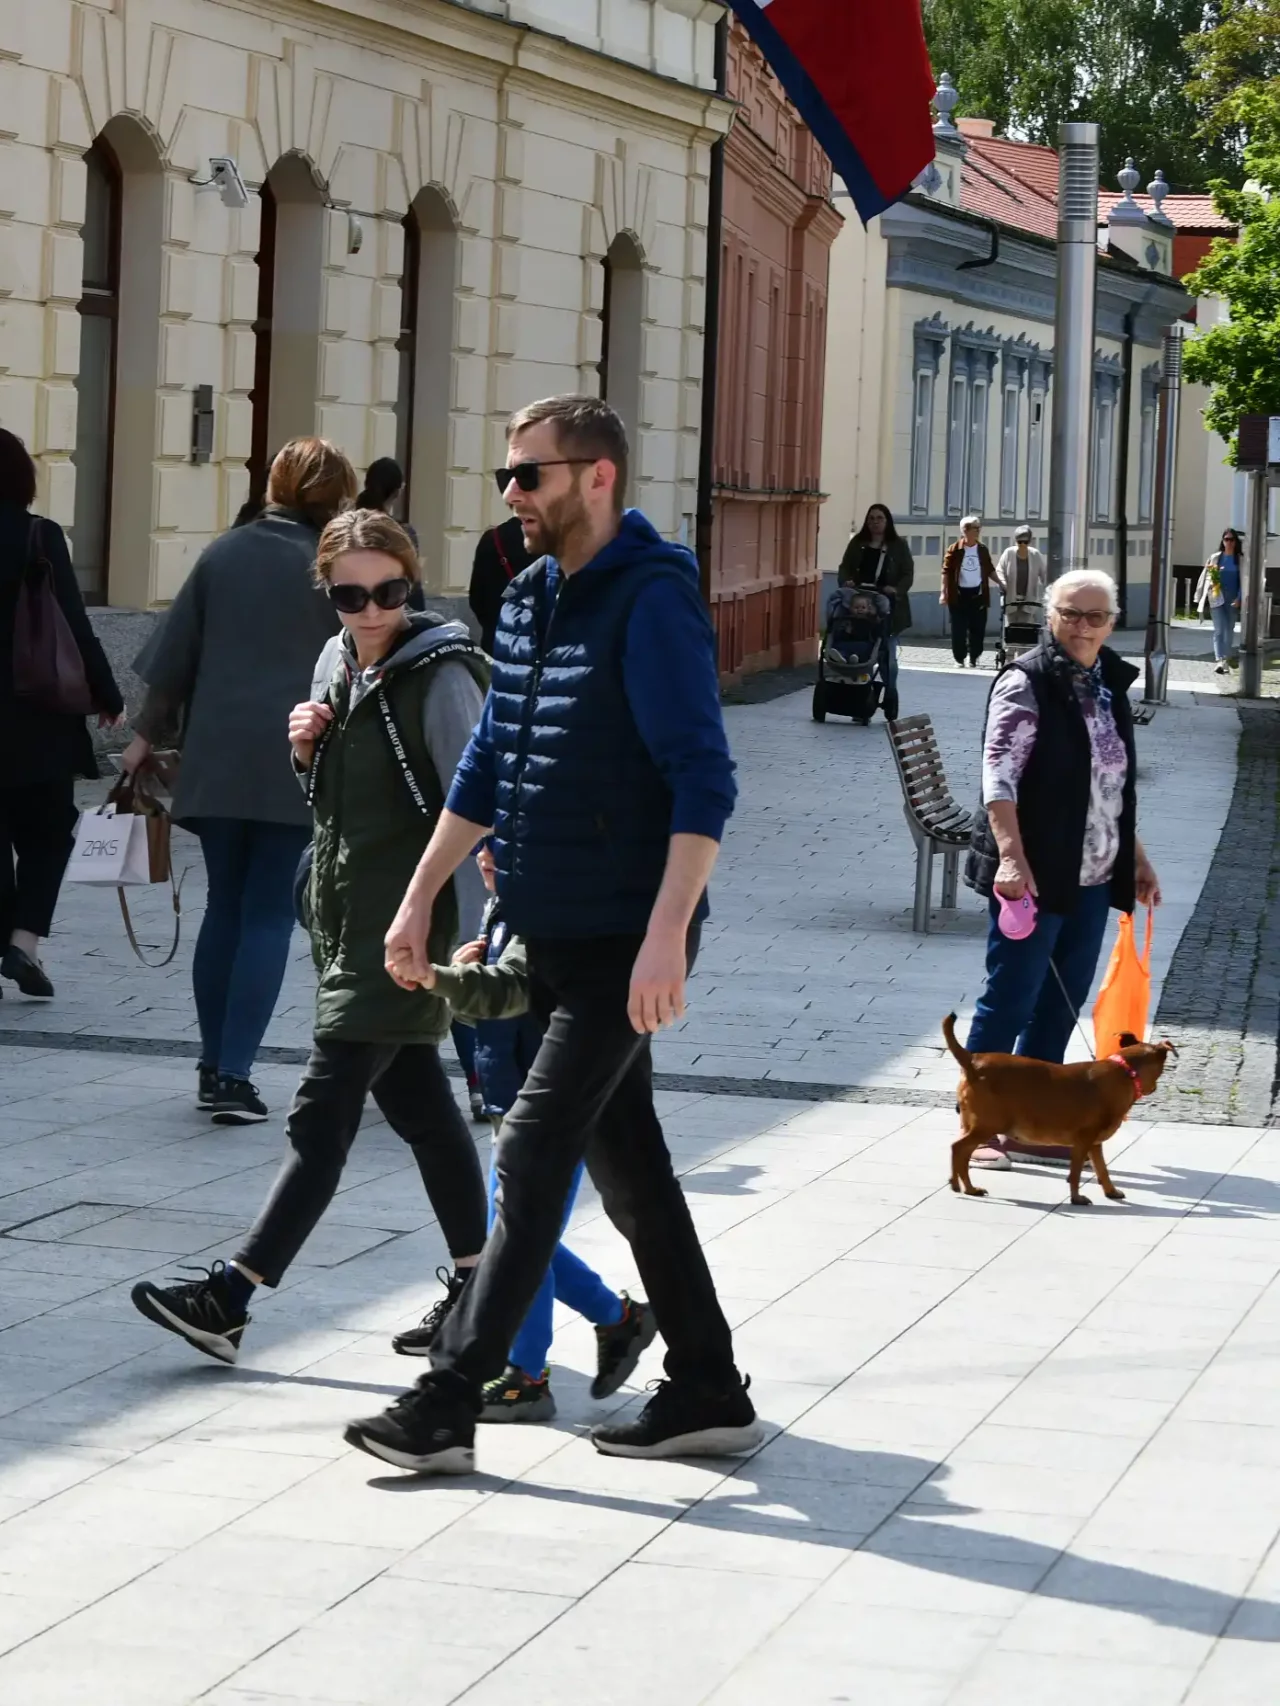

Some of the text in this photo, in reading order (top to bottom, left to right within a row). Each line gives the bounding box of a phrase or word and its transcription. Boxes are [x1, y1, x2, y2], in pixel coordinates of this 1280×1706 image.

[386, 722, 407, 761] BELOVED
[404, 770, 426, 807] BELOVED
[82, 839, 119, 857] ZAKS
